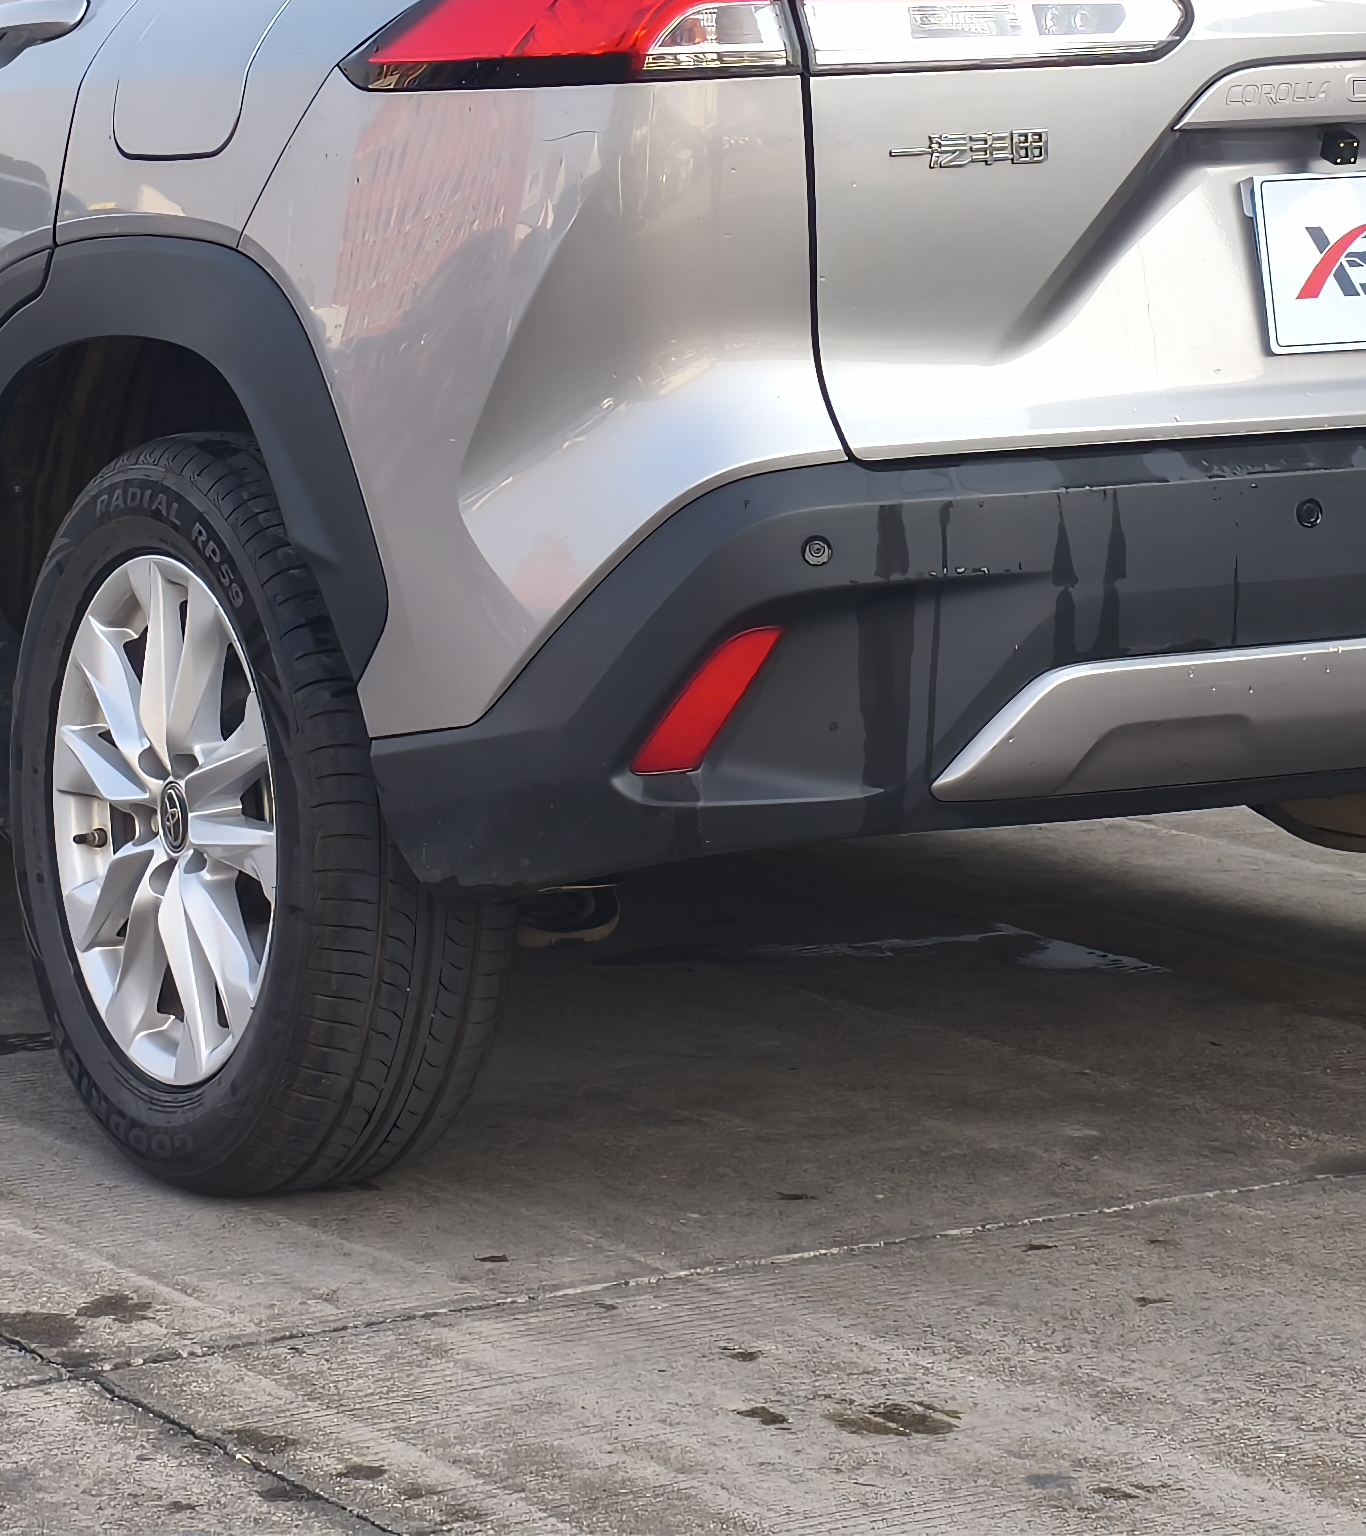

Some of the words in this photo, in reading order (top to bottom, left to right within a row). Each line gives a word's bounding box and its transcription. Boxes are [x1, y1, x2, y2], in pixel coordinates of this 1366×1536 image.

[1225, 80, 1331, 105] COROLLA
[889, 128, 1049, 169] 一汽丰田
[96, 487, 181, 526] RADIAL
[191, 522, 243, 609] RP59
[54, 1026, 194, 1160] GOODRID
